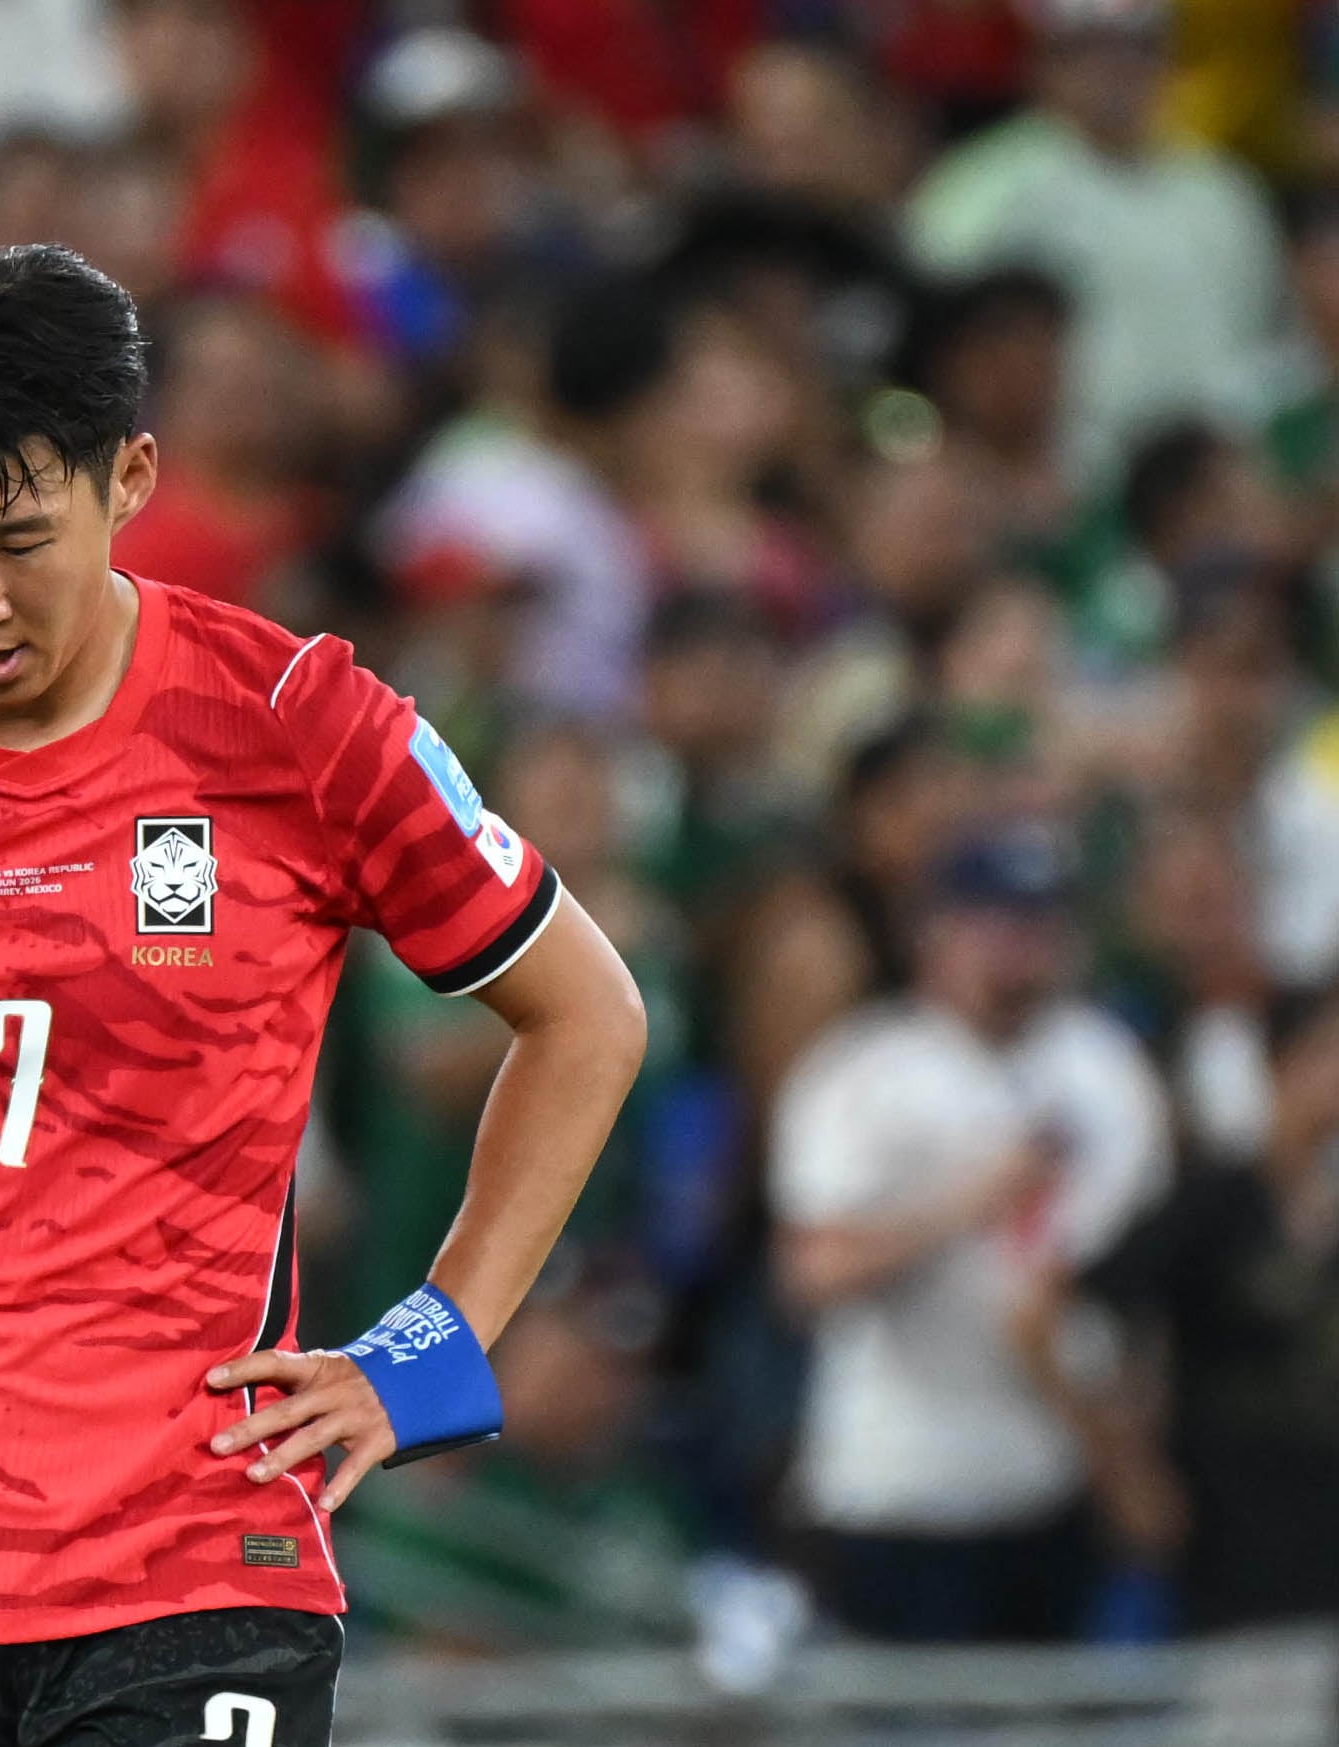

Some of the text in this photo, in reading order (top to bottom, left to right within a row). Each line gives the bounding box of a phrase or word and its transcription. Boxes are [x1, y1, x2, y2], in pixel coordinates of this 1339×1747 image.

[15, 867, 46, 877] KOREA
[48, 862, 94, 874] REPUBLIC
[20, 876, 41, 886] 2026
[25, 884, 62, 894] MEXICO
[131, 945, 213, 967] KOREA
[404, 1289, 460, 1340] OOTBALL
